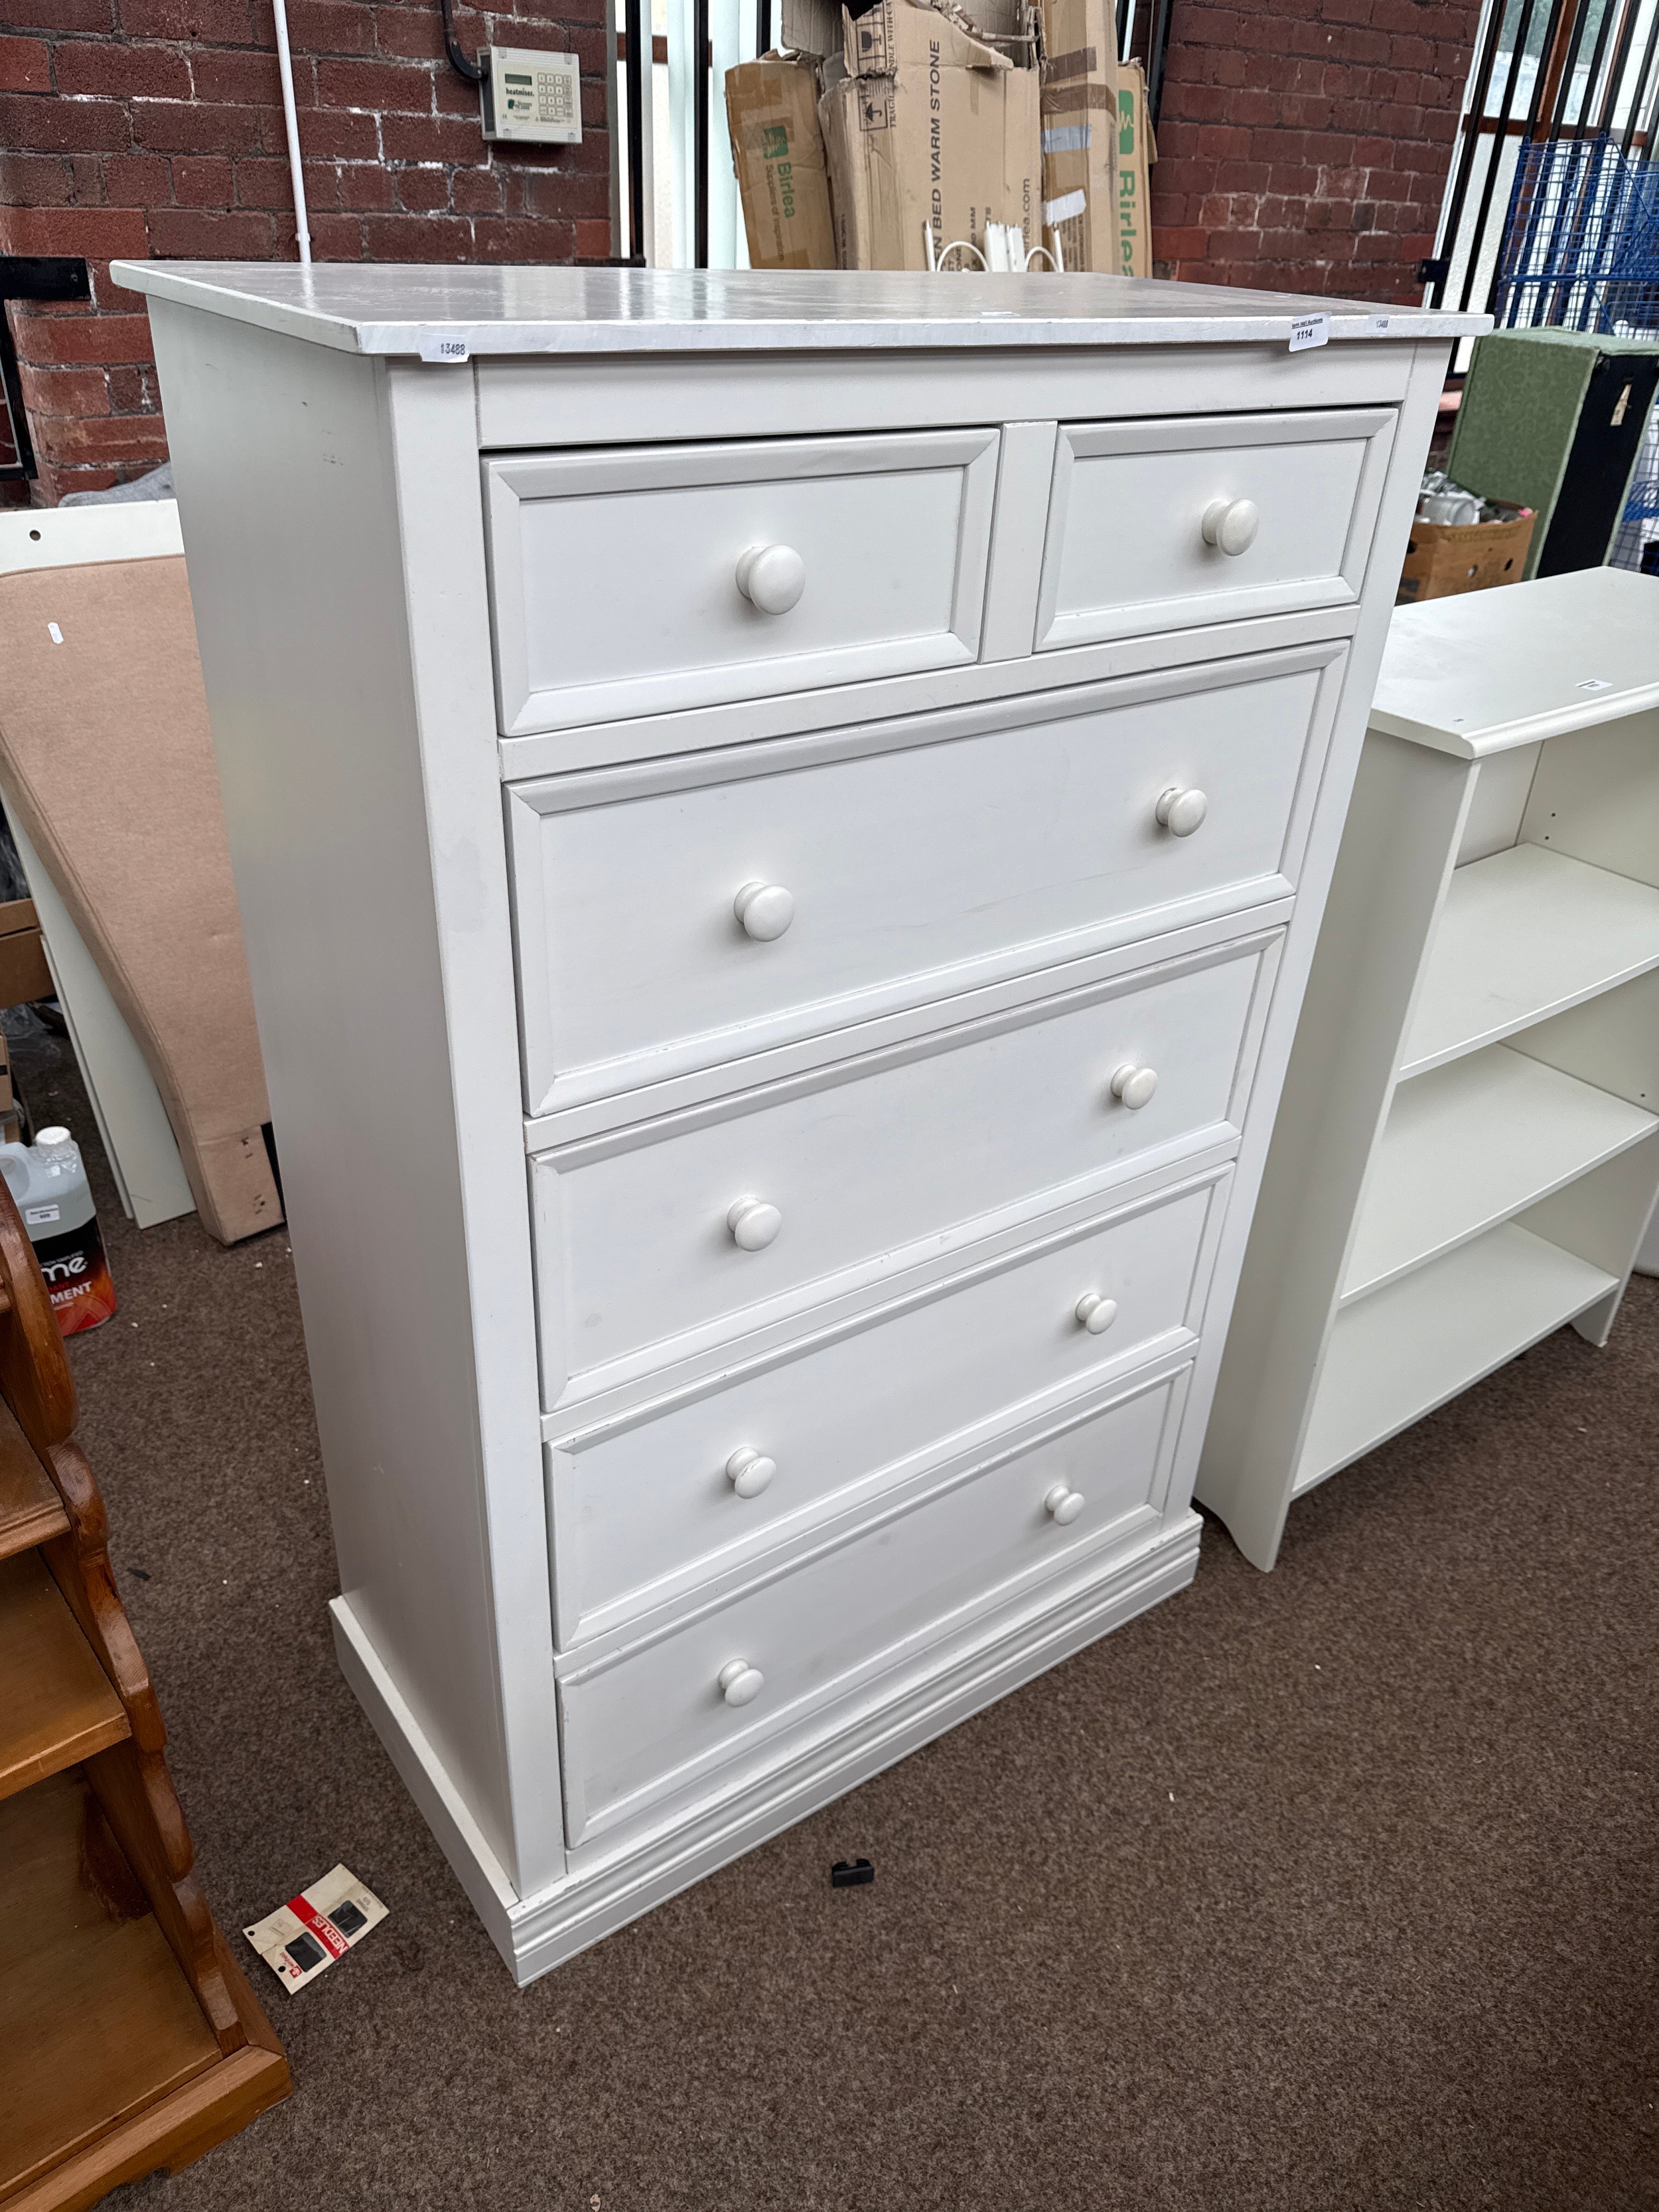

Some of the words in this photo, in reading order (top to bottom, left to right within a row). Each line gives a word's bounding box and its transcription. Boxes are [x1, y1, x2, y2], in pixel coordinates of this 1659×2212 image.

[930, 39, 940, 111] STONE
[930, 117, 941, 182] WARM
[777, 162, 795, 219] Birlea
[932, 188, 942, 230] BED
[441, 343, 465, 356] 13488
[1297, 329, 1313, 340] 1114
[50, 1281, 92, 1305] MENT
[311, 1915, 348, 1954] NEEDLES
